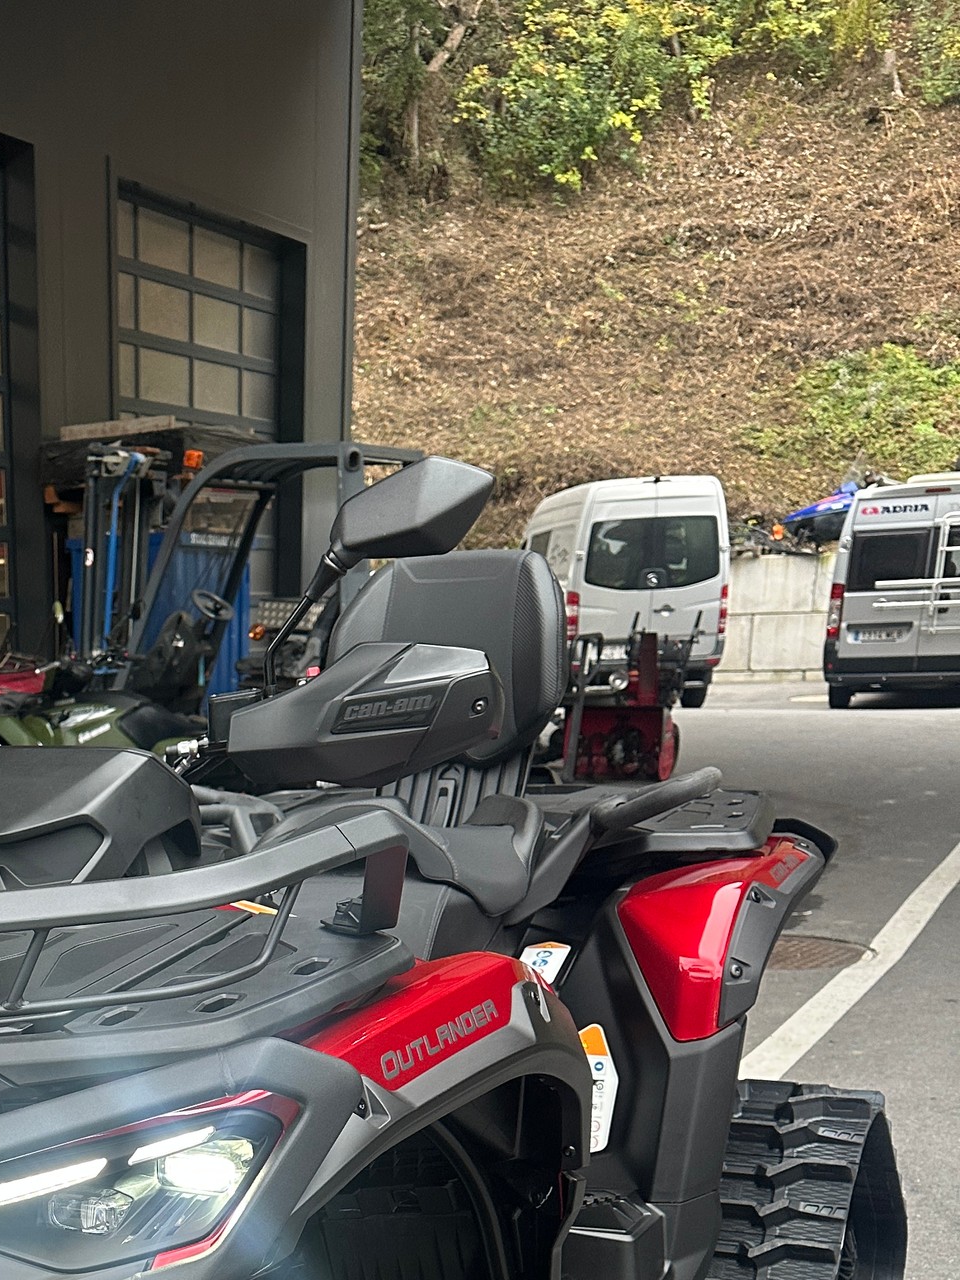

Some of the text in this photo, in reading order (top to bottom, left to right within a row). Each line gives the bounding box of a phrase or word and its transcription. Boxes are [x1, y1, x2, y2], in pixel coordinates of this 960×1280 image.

[881, 503, 929, 514] ADRIA
[343, 695, 433, 720] can-am
[380, 998, 499, 1080] OUTLANDER
